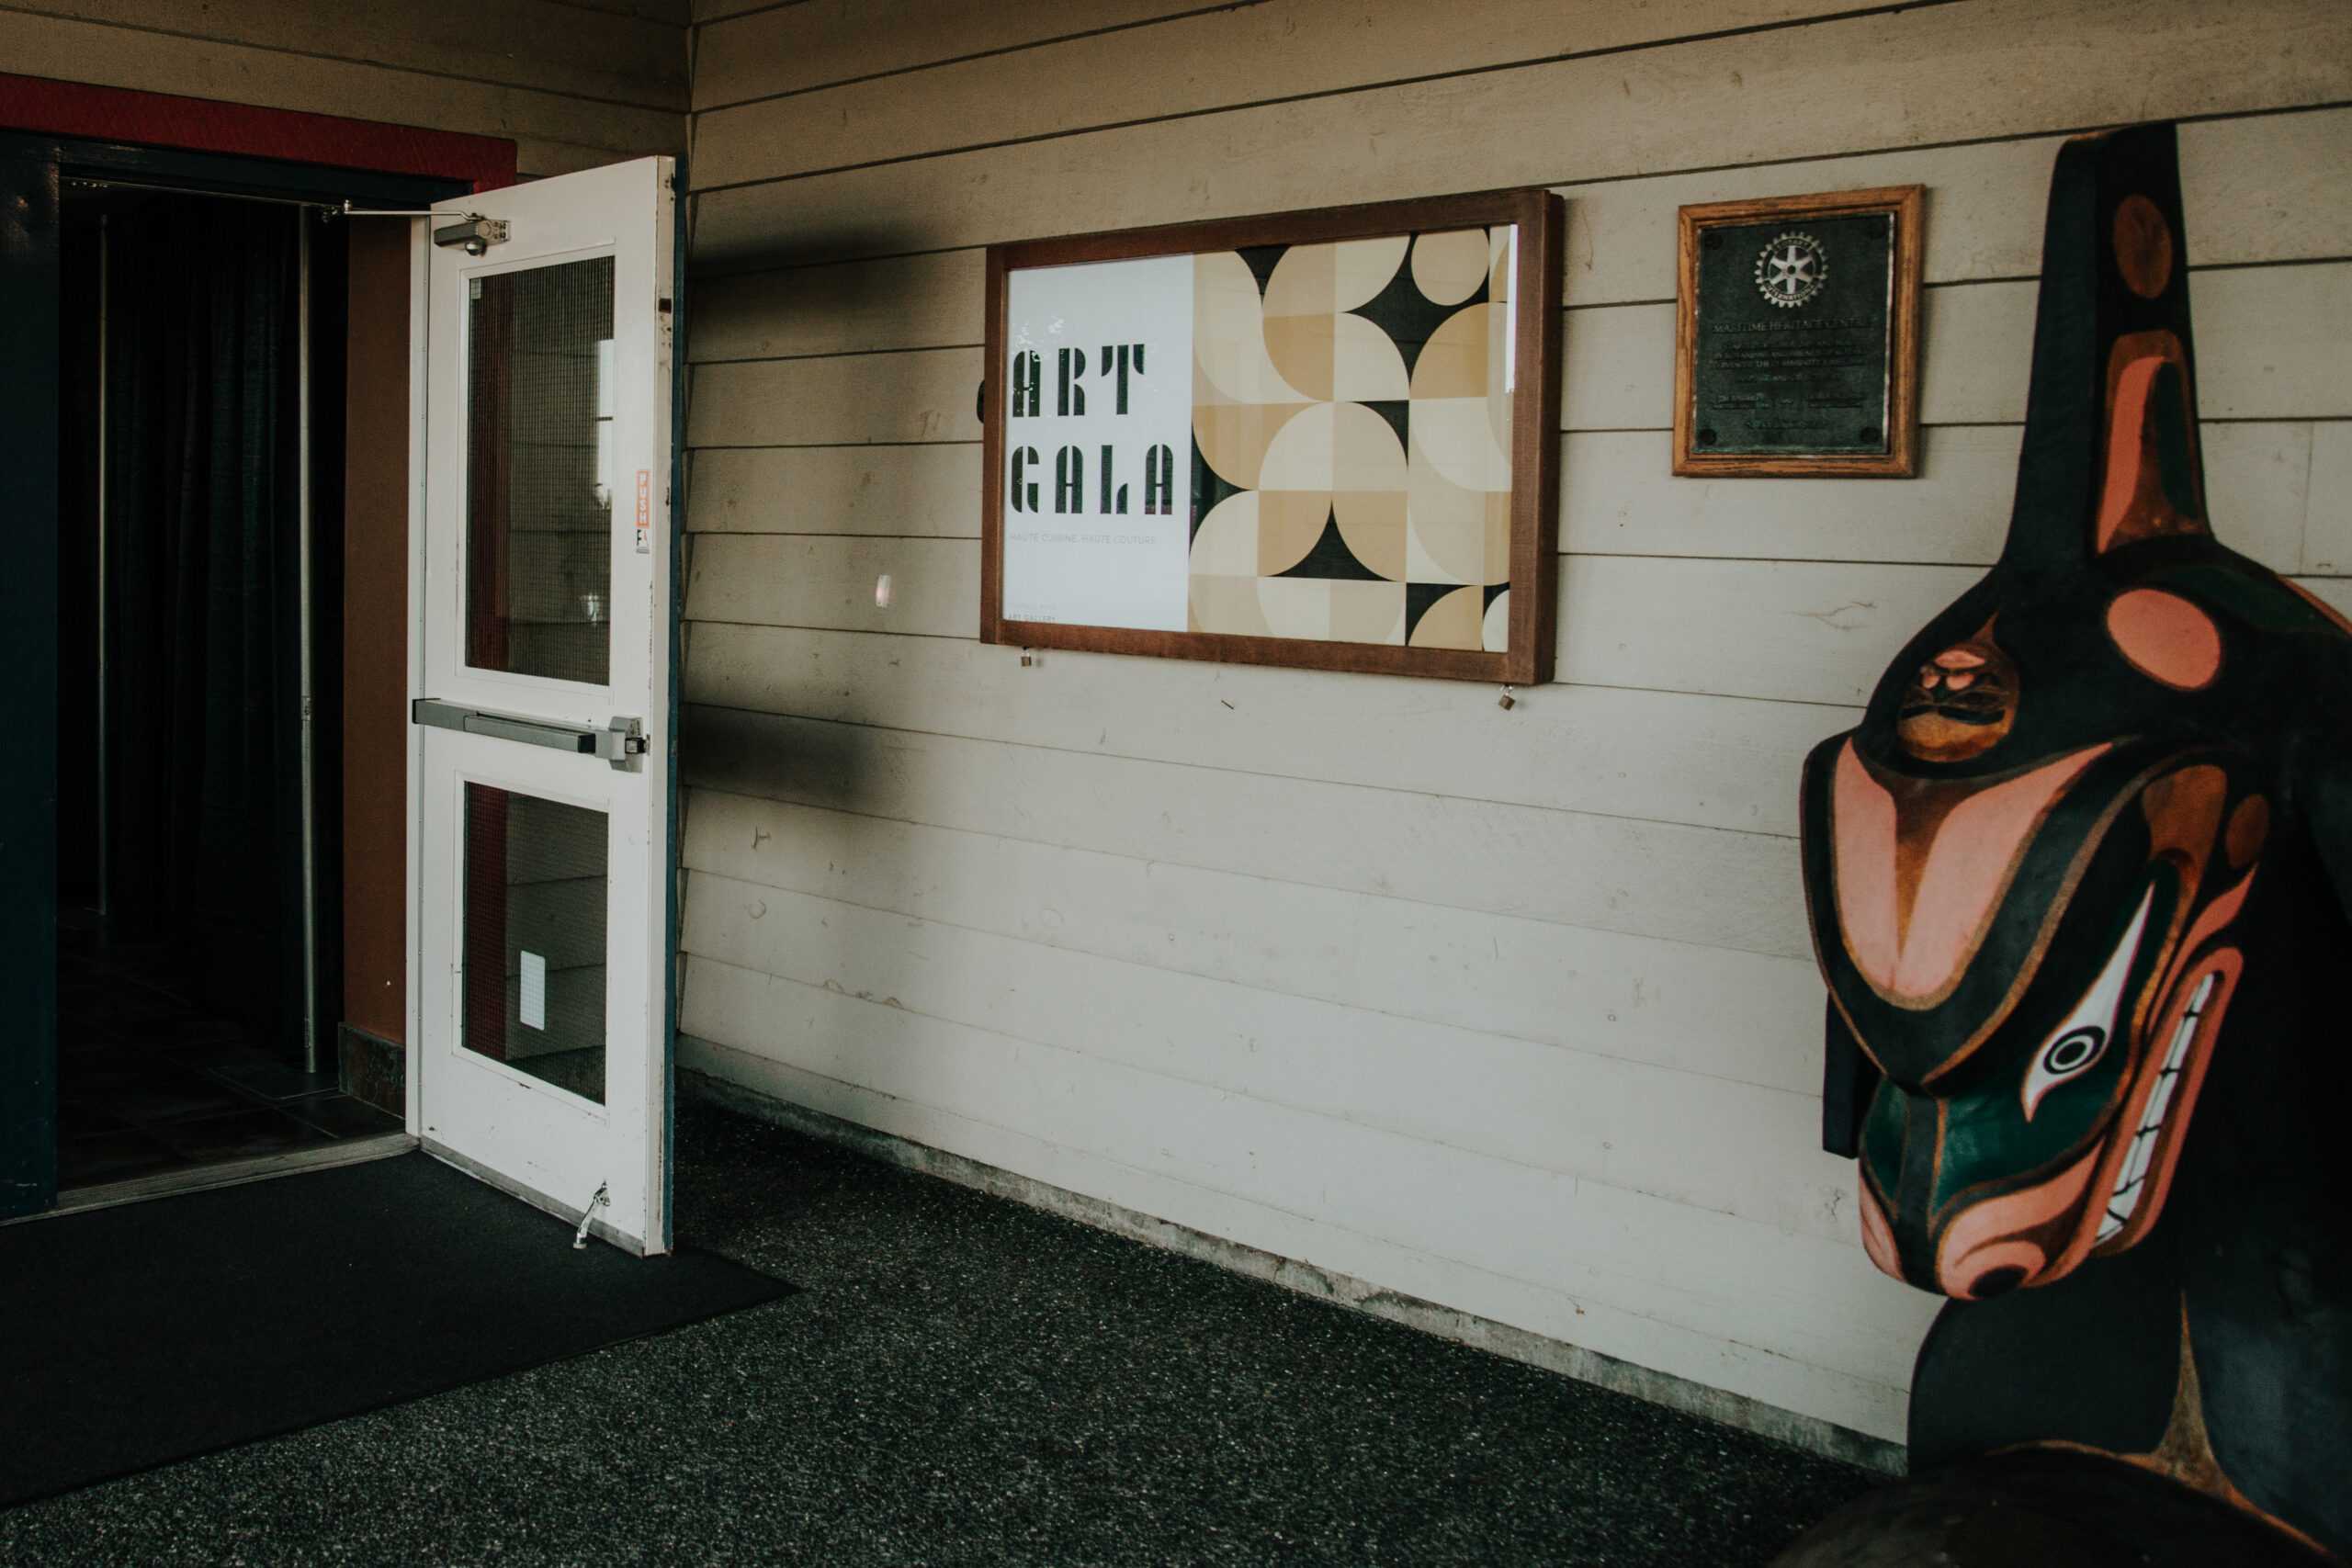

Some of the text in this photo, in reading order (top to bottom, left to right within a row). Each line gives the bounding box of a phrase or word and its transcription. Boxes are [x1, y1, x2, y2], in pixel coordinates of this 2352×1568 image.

[1012, 343, 1145, 417] ART
[639, 471, 648, 525] PUSH
[1011, 444, 1174, 515] GALA
